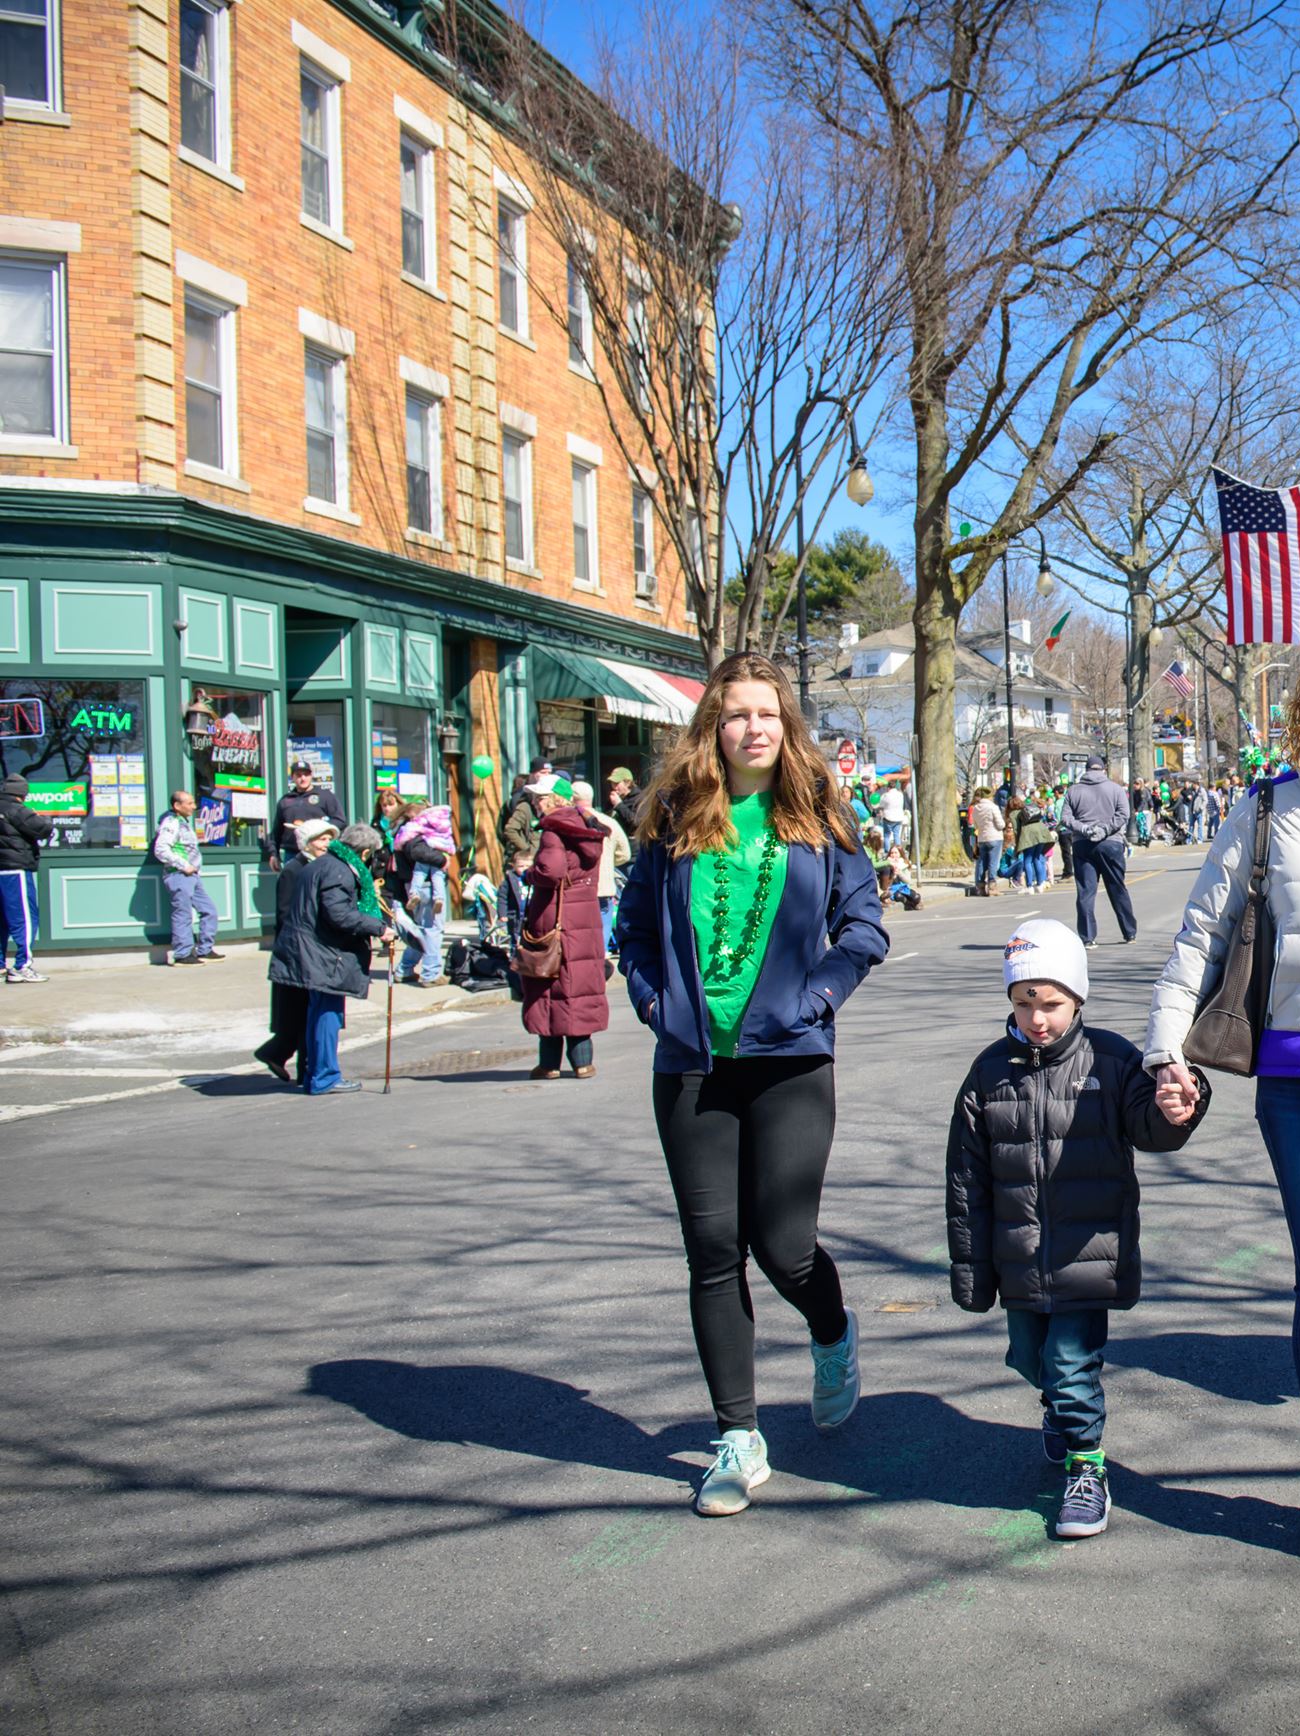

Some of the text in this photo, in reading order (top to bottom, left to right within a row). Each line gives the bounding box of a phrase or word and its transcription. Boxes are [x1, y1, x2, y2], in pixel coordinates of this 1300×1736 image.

[71, 708, 131, 731] ATM
[25, 790, 74, 805] ewport
[53, 817, 81, 825] PRICE
[200, 801, 225, 824] Quick
